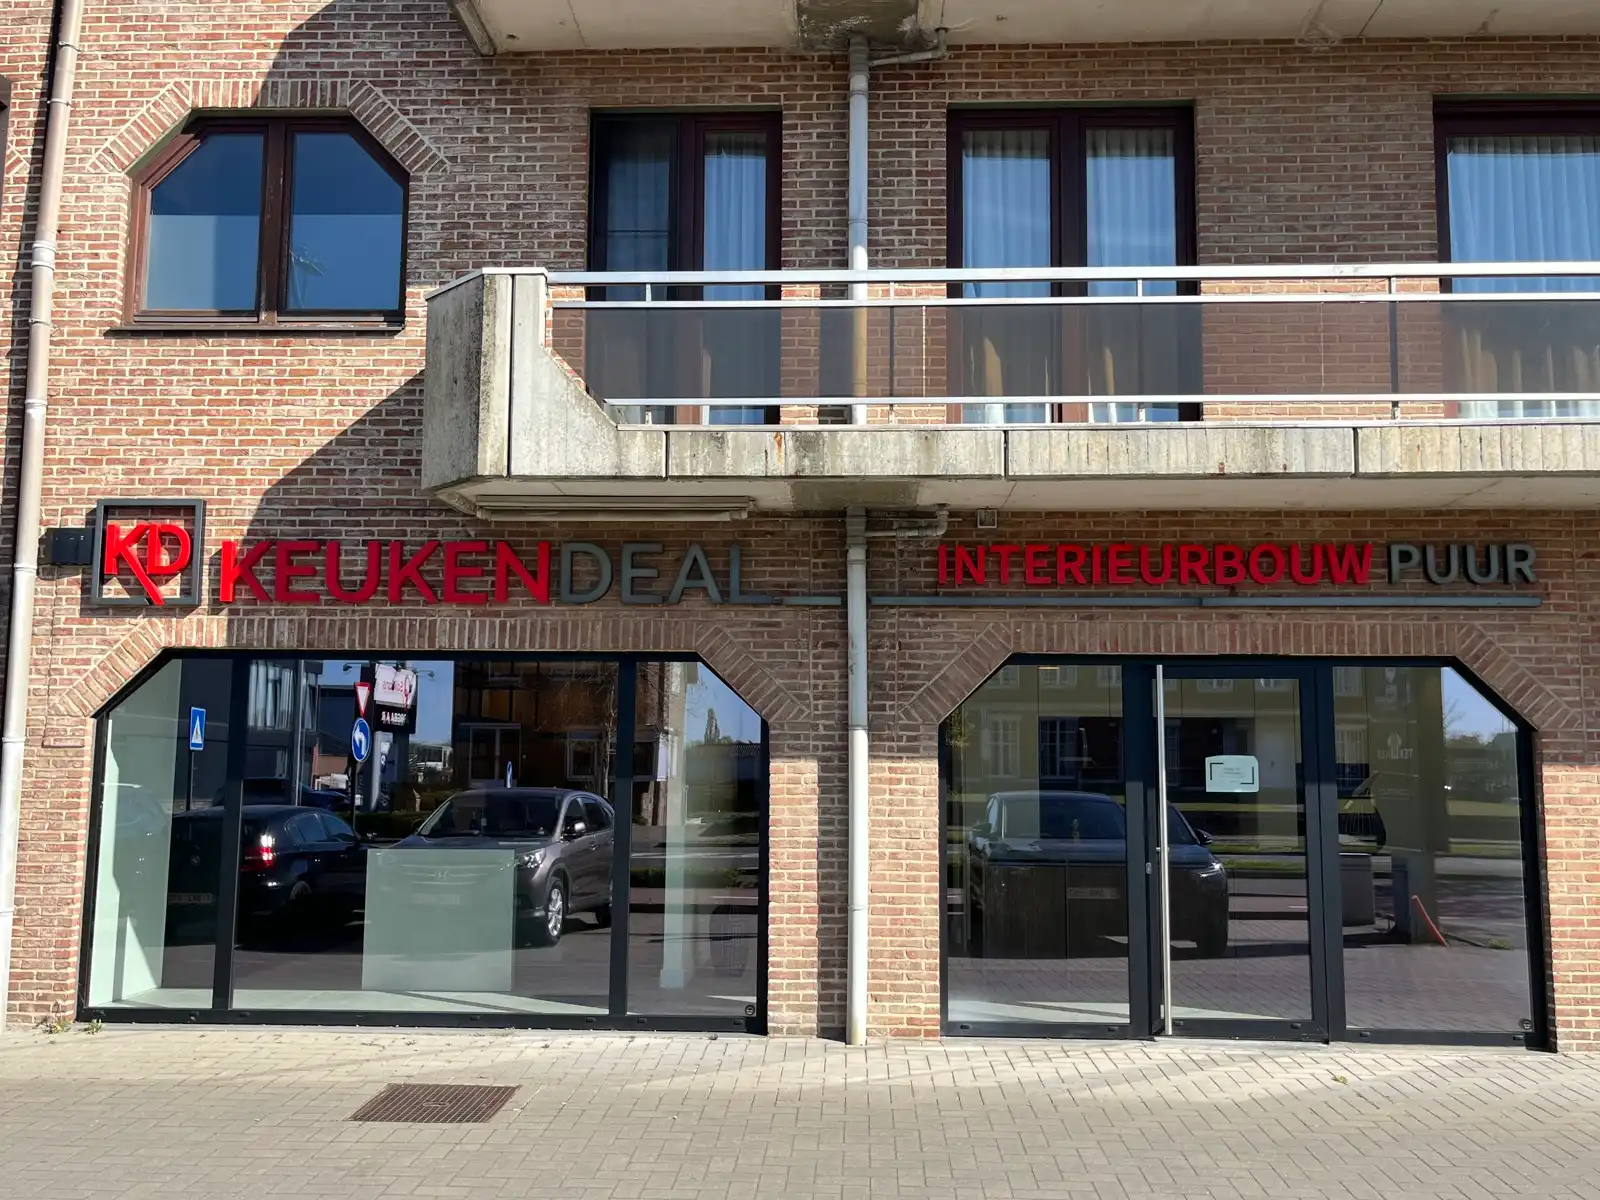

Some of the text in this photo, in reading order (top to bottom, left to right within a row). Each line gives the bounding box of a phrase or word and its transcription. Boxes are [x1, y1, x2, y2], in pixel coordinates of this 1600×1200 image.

[104, 523, 193, 605] KD
[219, 540, 773, 605] KEUKENDEAL
[937, 542, 1538, 586] INTERIEURBOUW PUUR
